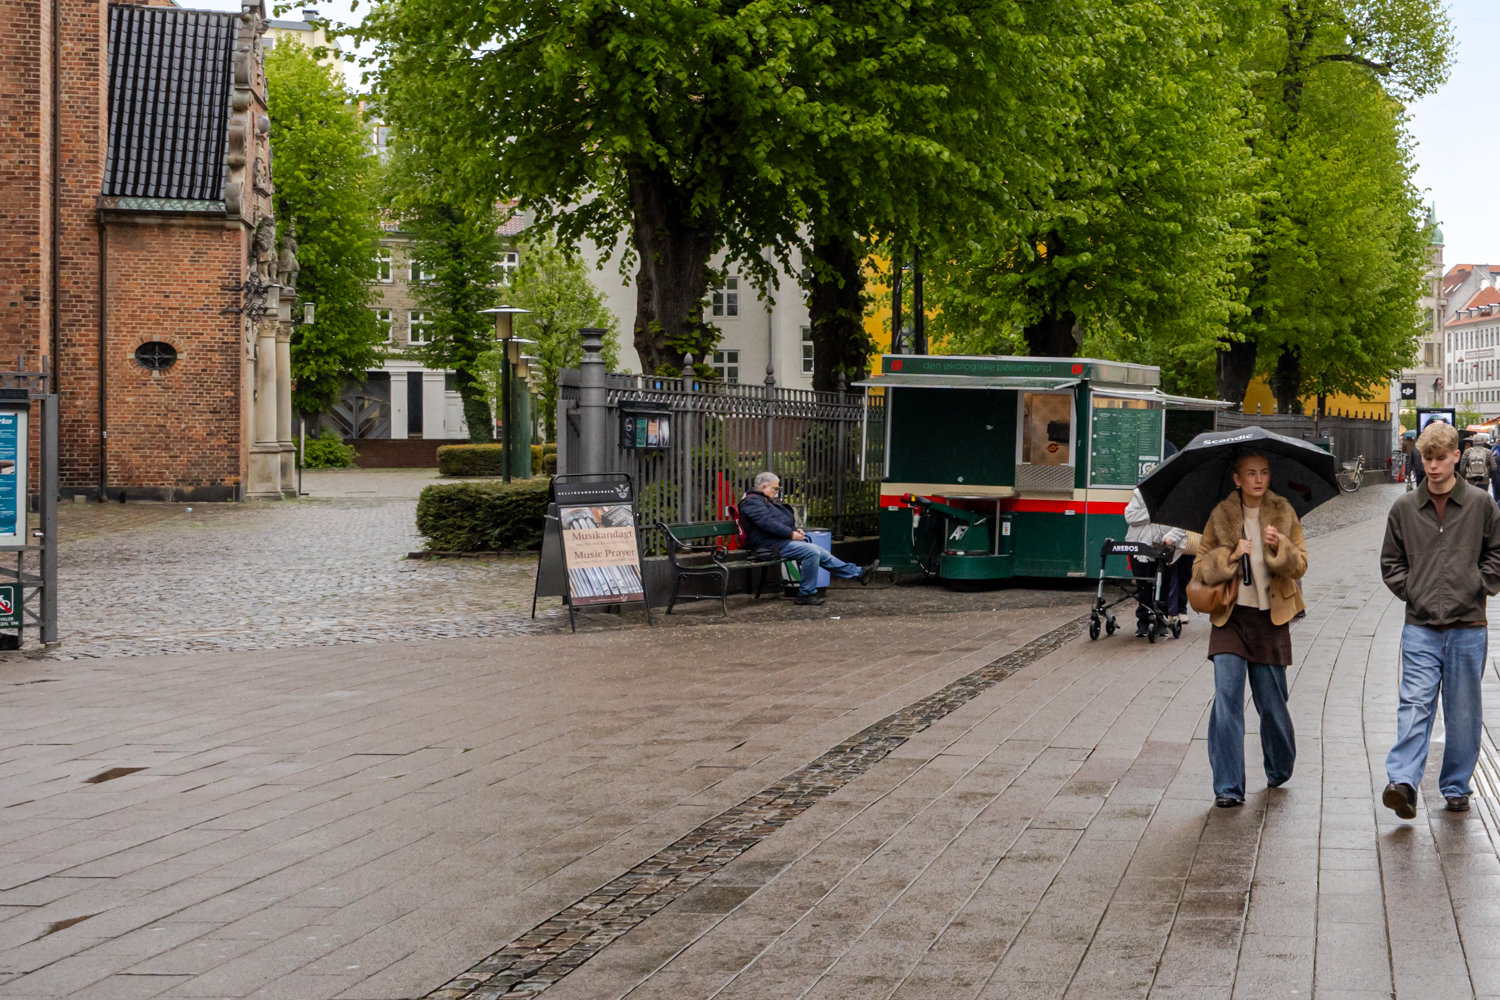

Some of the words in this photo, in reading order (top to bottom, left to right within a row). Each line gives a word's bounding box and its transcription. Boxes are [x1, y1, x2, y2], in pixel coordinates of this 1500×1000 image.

[1203, 433, 1253, 446] Scandic
[571, 529, 634, 541] Musikandagt
[573, 550, 603, 560] Music
[604, 549, 636, 560] Prayer
